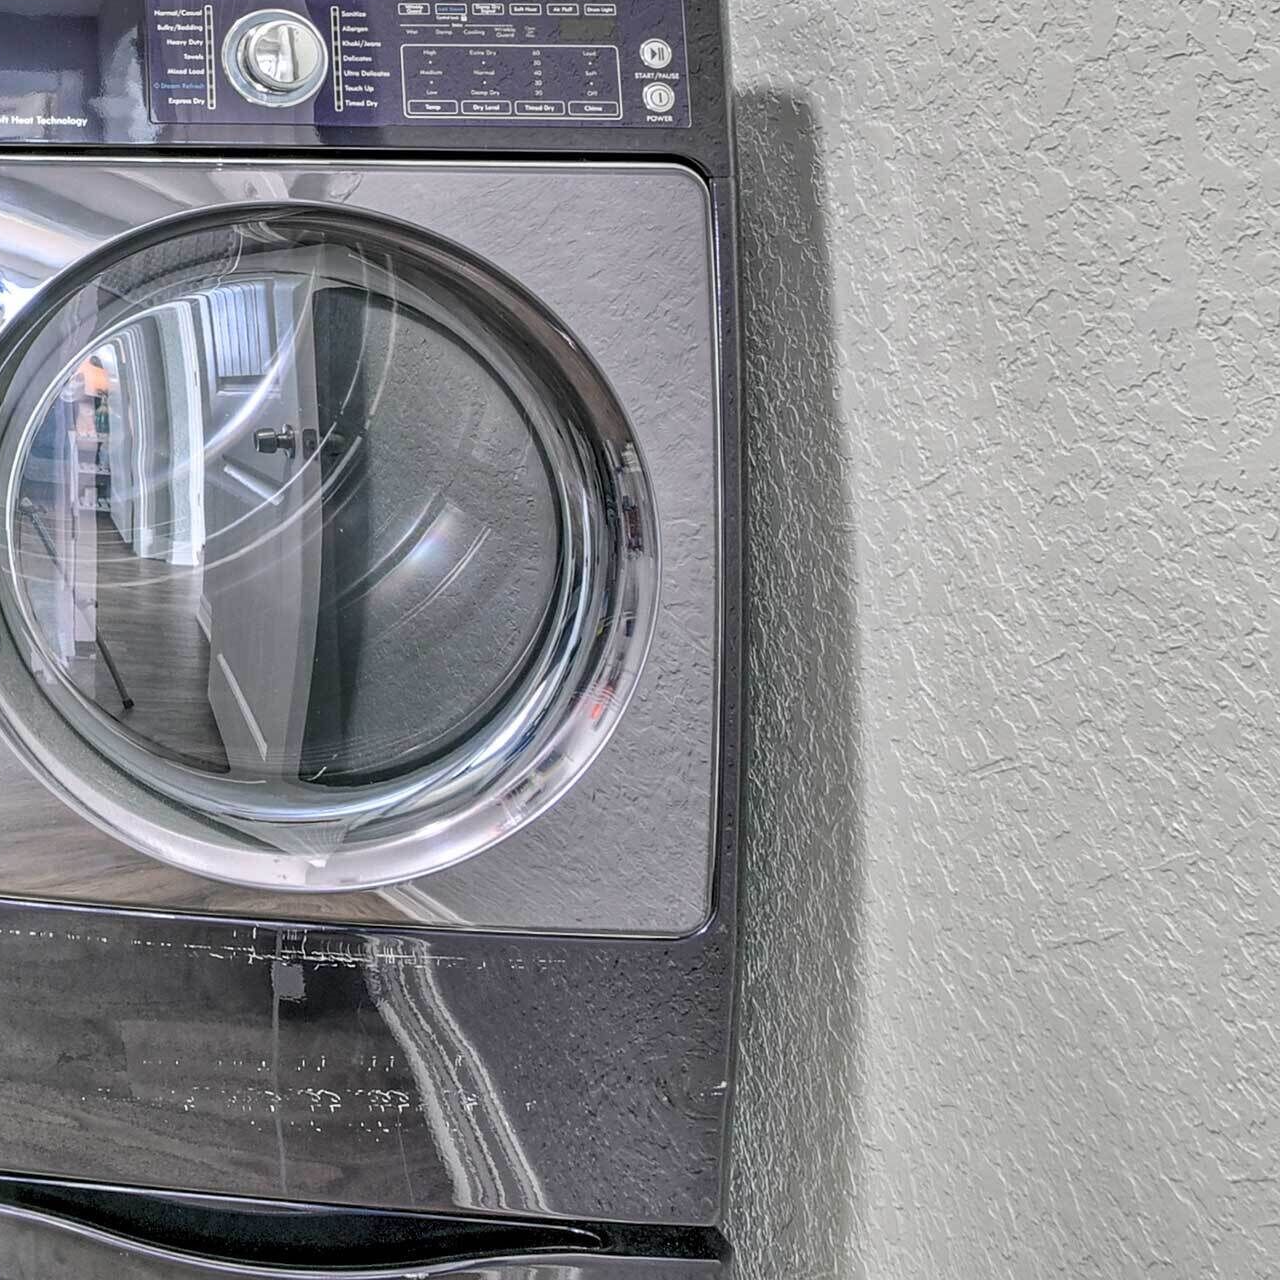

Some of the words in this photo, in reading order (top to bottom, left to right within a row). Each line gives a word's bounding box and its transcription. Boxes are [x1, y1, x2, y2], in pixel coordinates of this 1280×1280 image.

[635, 72, 679, 80] START/PAUSE
[192, 98, 205, 106] Dry
[11, 115, 33, 124] Heat
[36, 115, 88, 127] Technology
